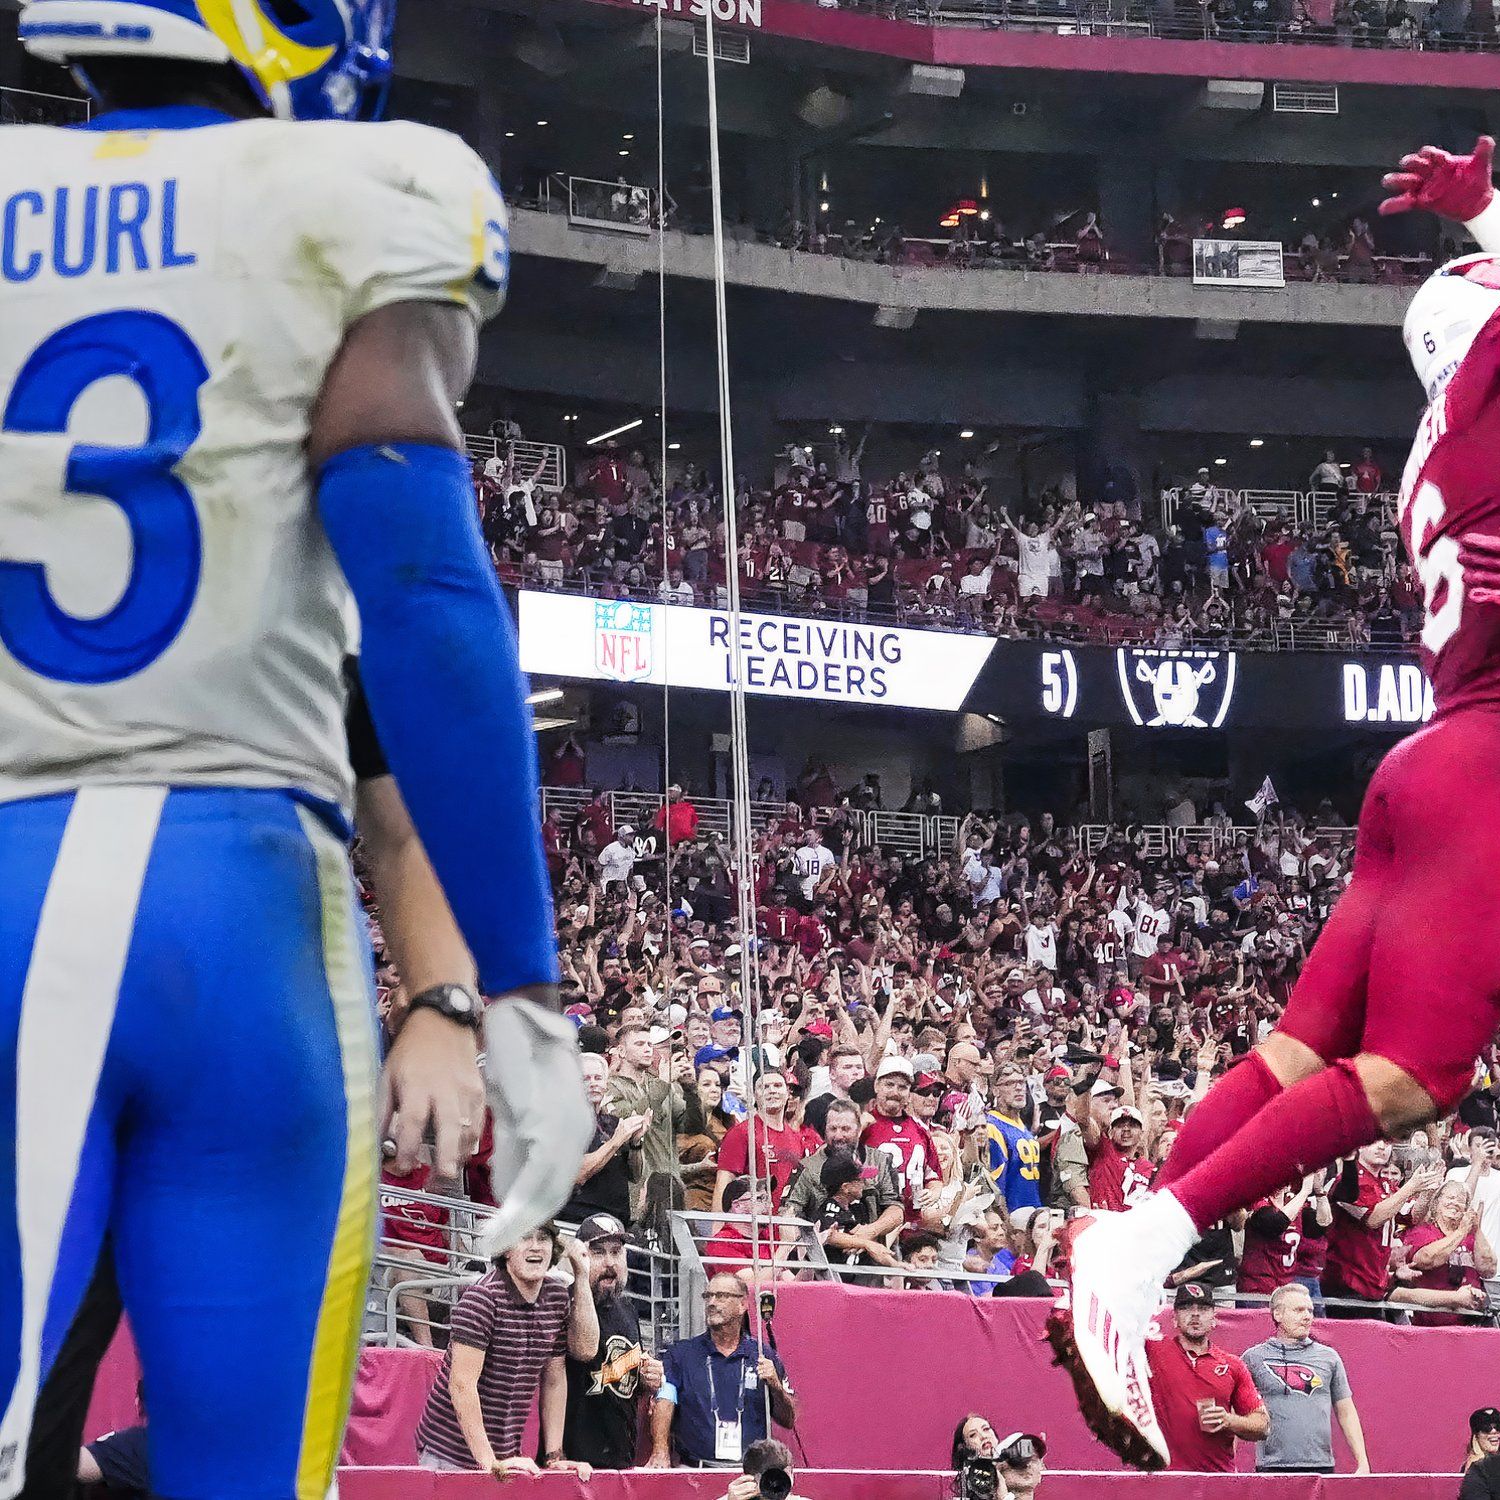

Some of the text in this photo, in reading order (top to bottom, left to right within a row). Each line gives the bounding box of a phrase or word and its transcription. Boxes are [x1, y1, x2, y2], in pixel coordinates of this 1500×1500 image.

[632, 0, 762, 27] SON
[1, 178, 199, 283] CURL
[1423, 331, 1436, 354] 6
[0, 307, 212, 685] 3
[1410, 479, 1465, 657] 6
[601, 633, 647, 676] NFL
[709, 616, 902, 664] RECEIVING
[726, 655, 888, 698] LEADERS
[1041, 649, 1078, 718] 5)
[805, 859, 820, 876] 18
[779, 917, 786, 937] 1
[1139, 914, 1159, 937] 81
[1095, 942, 1115, 964] 40
[1162, 963, 1177, 981] 11
[1282, 1231, 1301, 1267] 3
